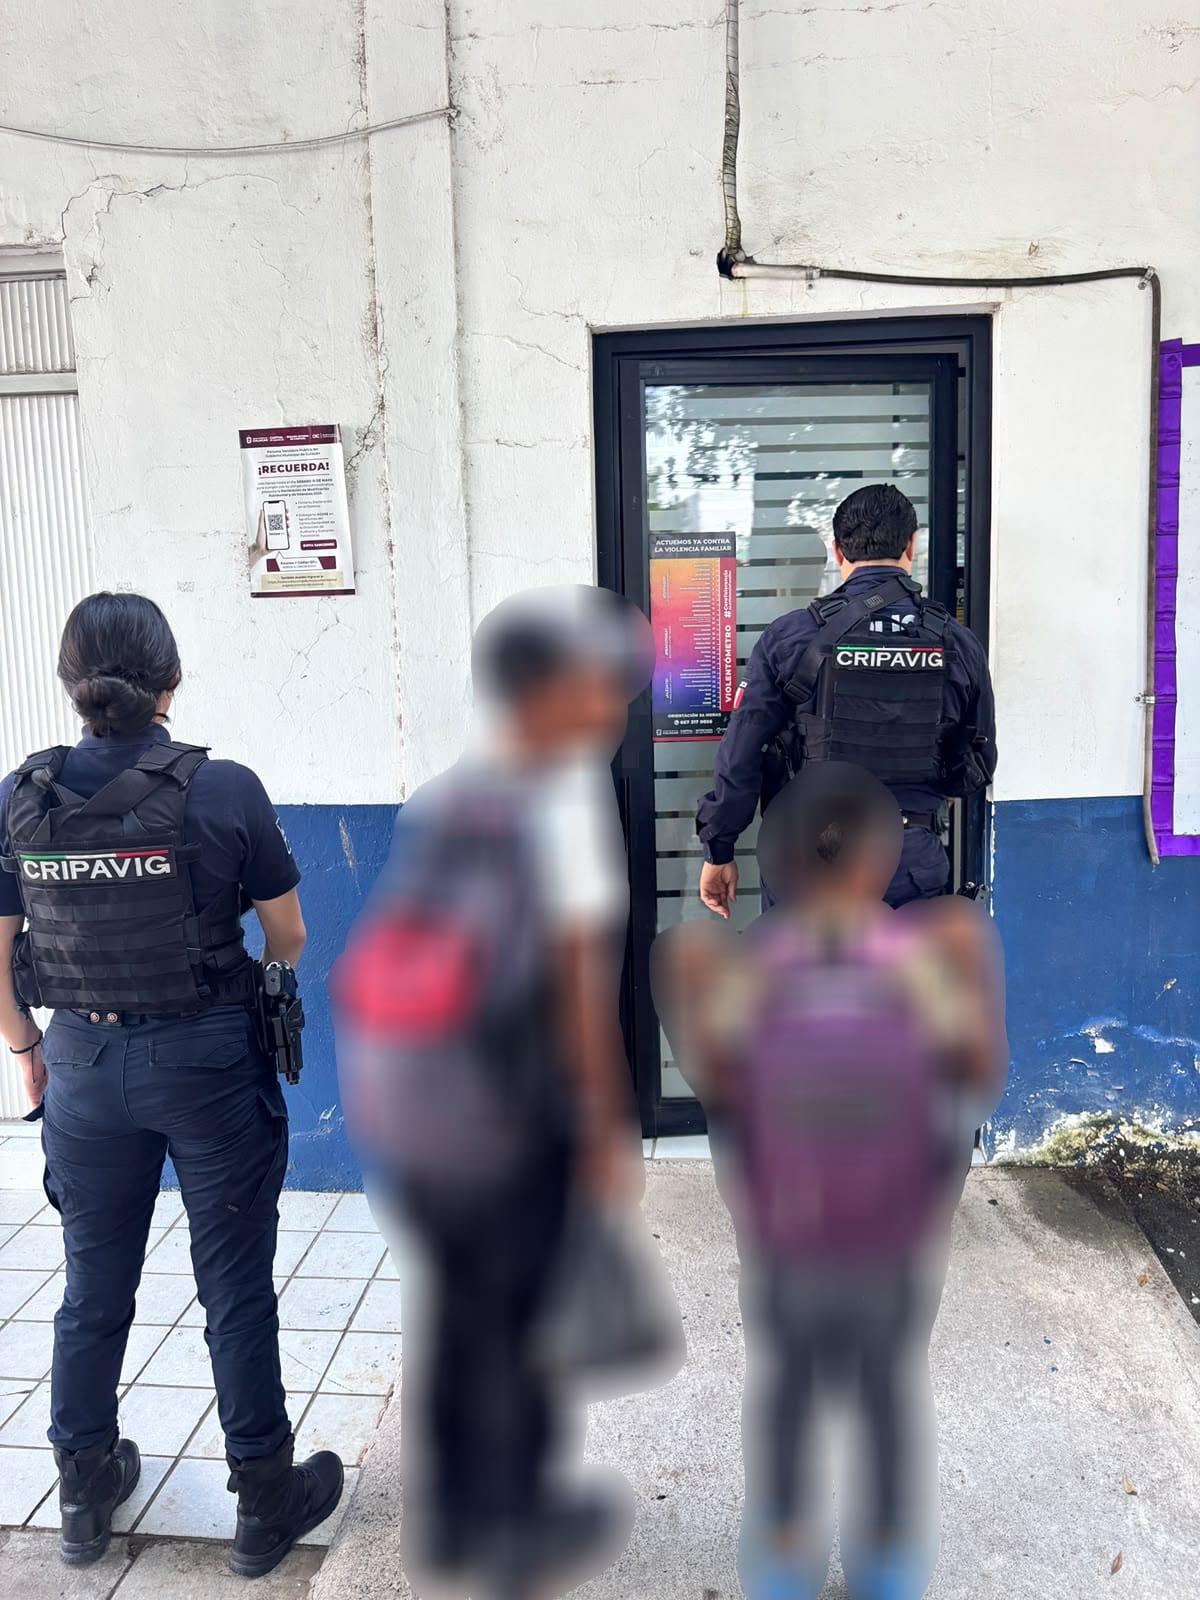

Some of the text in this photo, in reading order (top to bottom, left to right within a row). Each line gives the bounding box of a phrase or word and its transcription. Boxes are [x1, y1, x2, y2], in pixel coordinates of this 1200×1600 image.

[258, 462, 330, 475] ¡RECUERDA!
[724, 625, 732, 703] VIOLENTÓMETRO
[836, 651, 943, 667] CRIPAVIG
[23, 855, 171, 880] CRIPAVIG
